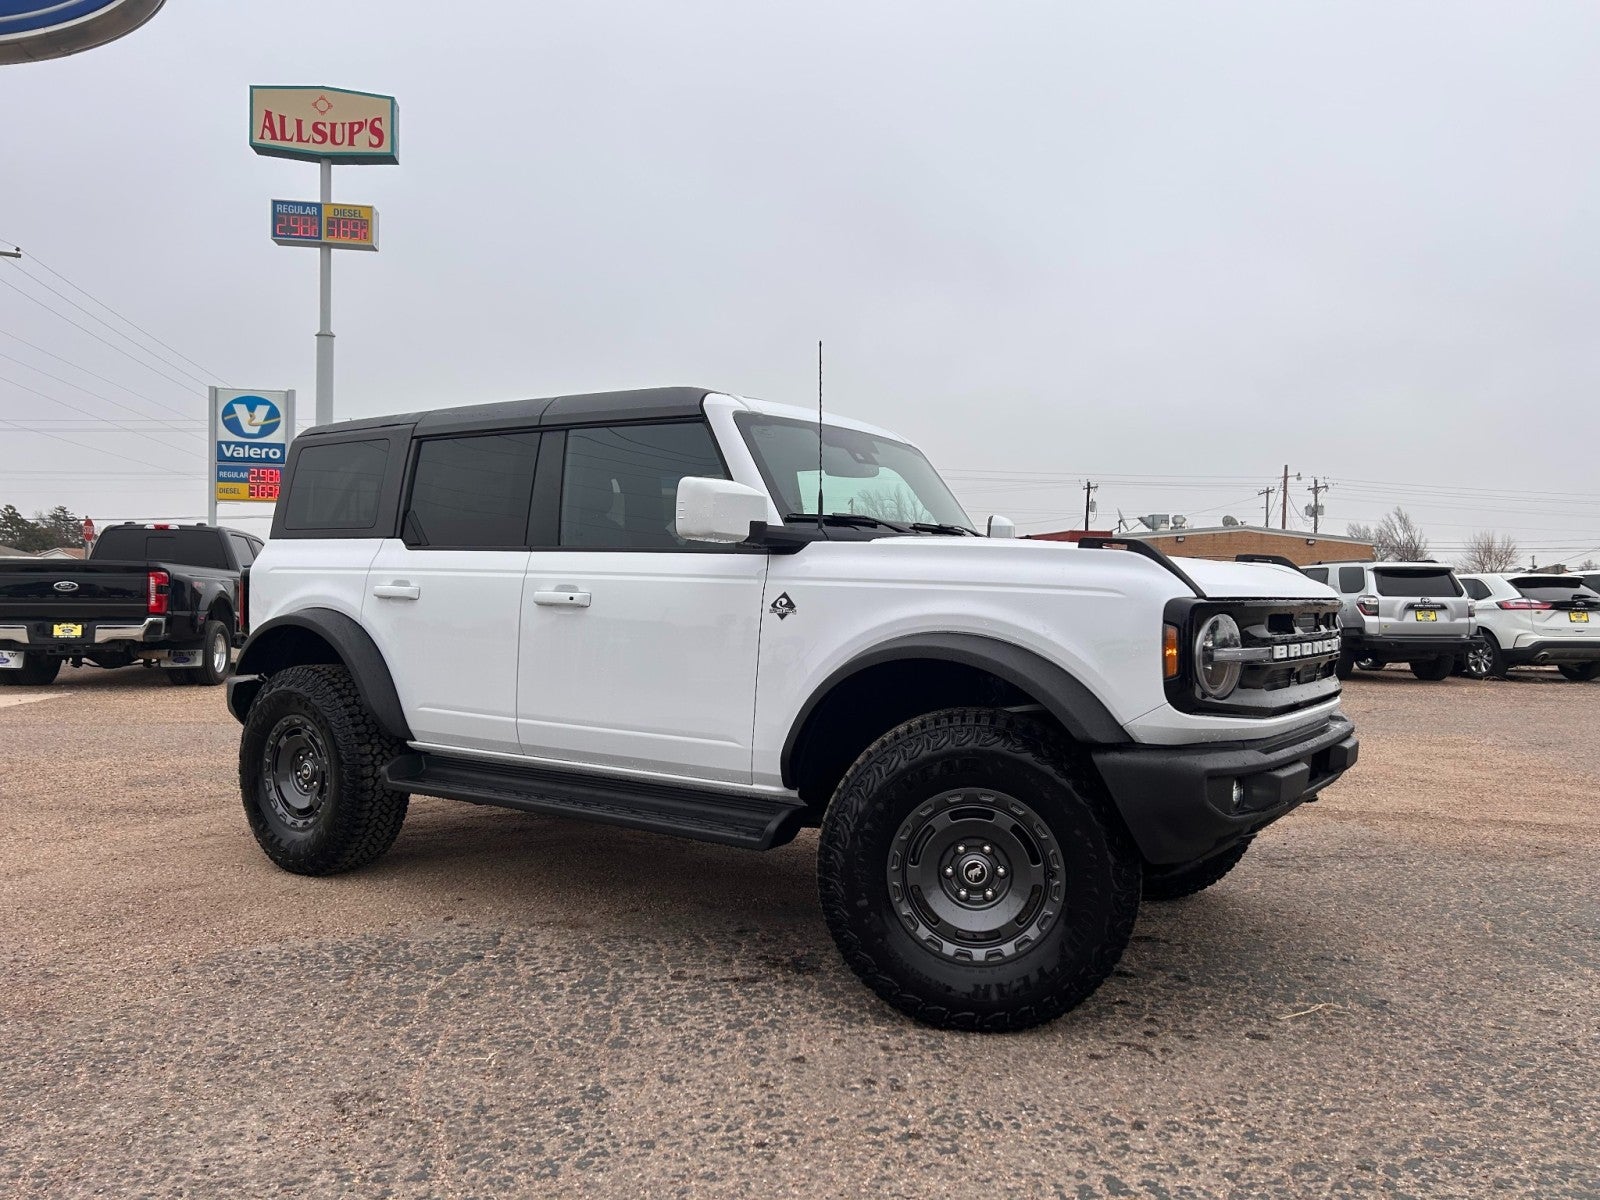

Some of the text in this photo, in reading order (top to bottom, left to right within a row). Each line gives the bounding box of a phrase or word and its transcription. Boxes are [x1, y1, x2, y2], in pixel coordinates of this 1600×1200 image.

[259, 109, 385, 149] ALLSUP'S
[276, 204, 318, 216] REGULAR
[333, 208, 363, 218] DIESEL
[221, 443, 281, 459] Valero
[219, 470, 249, 479] REGULAR
[218, 487, 241, 495] DIESEL
